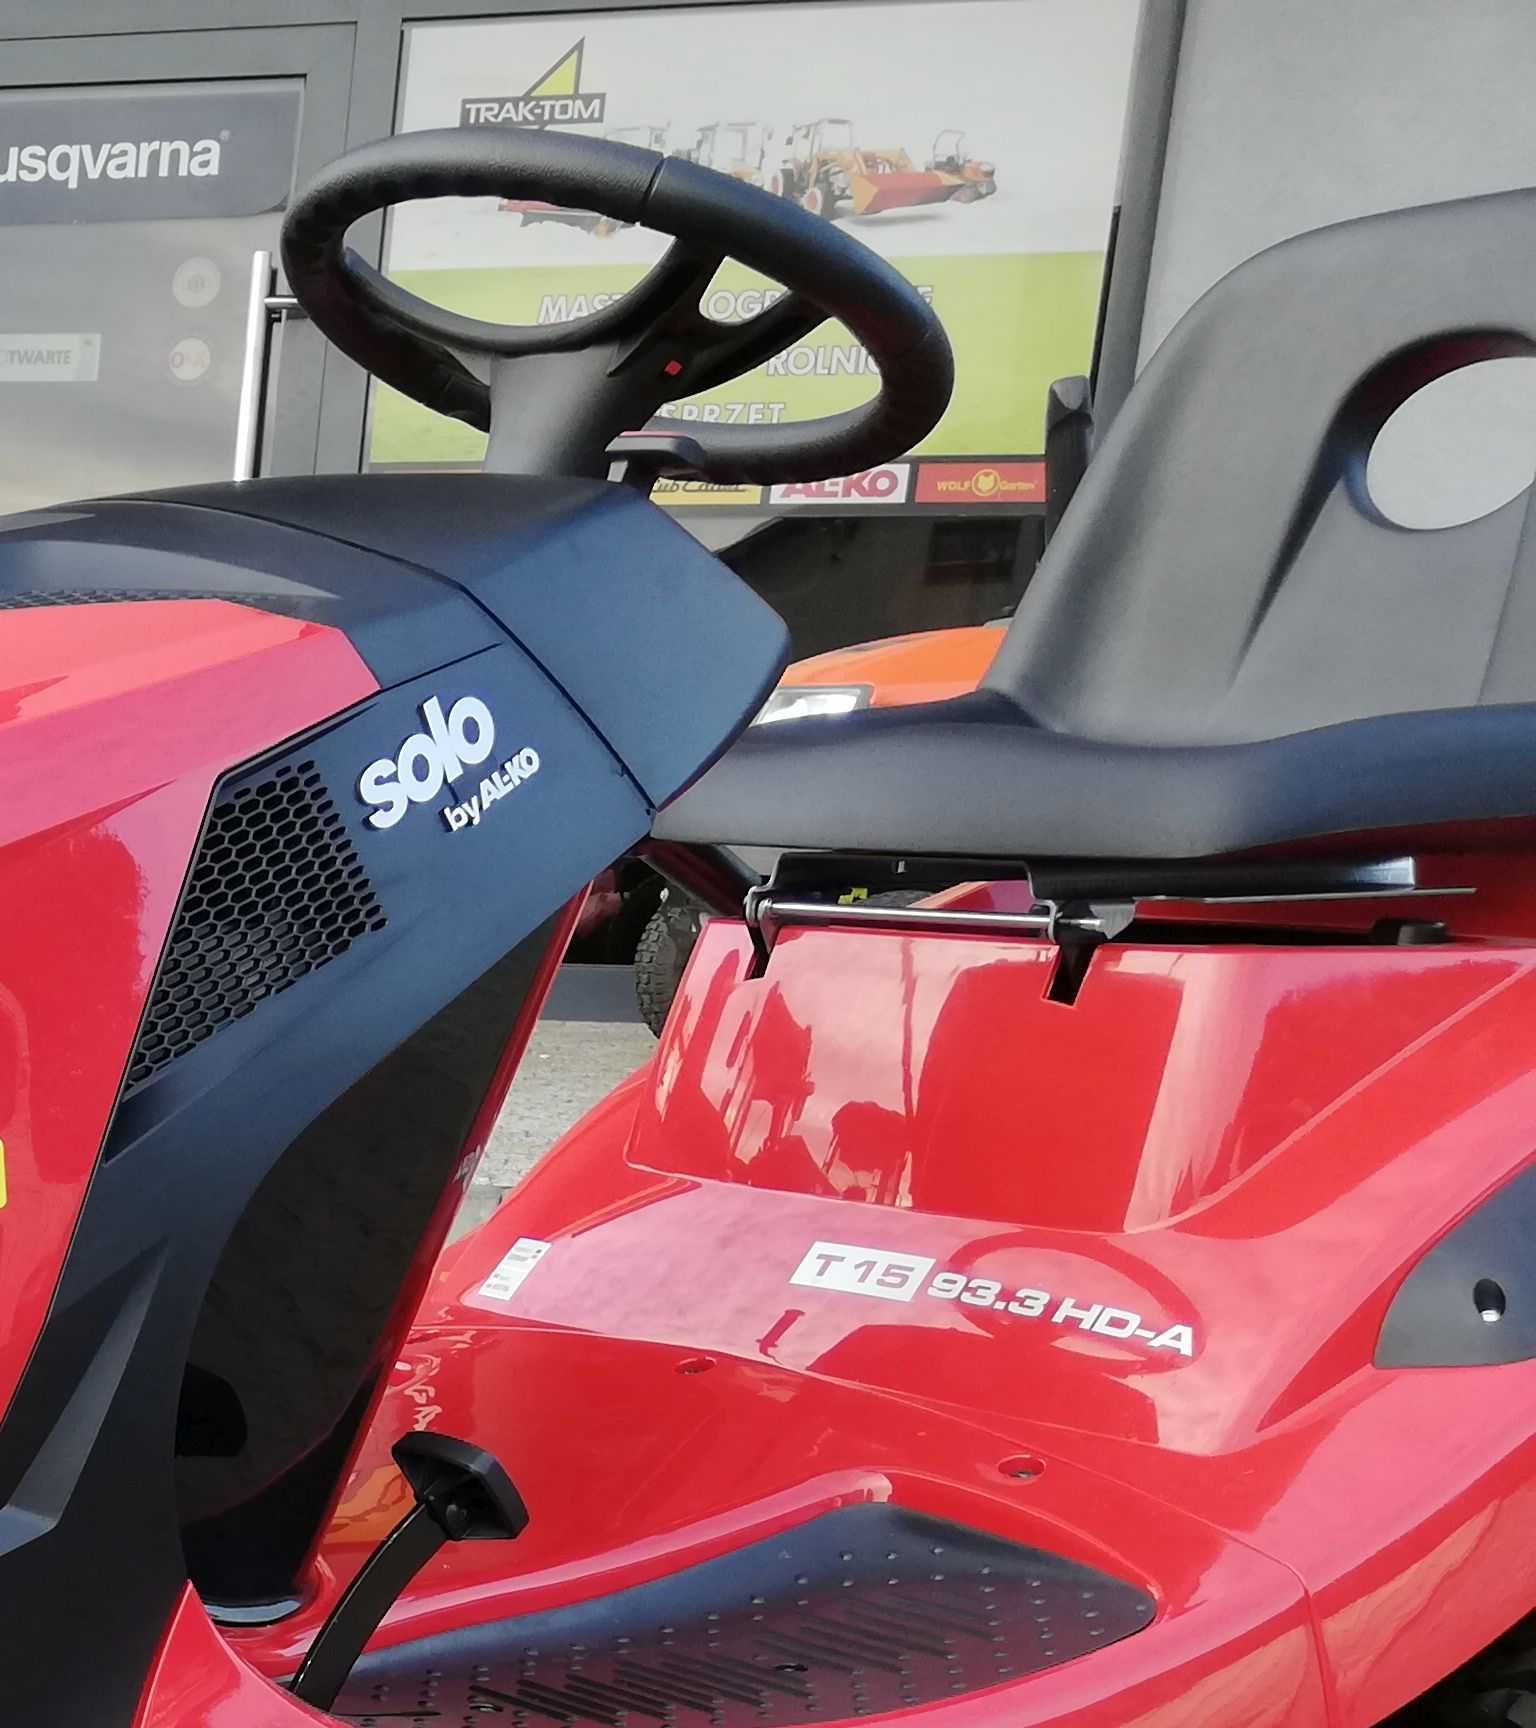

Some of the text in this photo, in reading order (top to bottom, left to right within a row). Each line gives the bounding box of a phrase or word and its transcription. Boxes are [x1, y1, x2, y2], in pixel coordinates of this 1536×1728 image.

[465, 99, 601, 123] TRAK-TOM
[936, 480, 972, 491] WOLF
[359, 695, 496, 829] solo
[443, 747, 540, 832] by AL-KO
[813, 1253, 1195, 1357] T 15 93.3 HD-A
